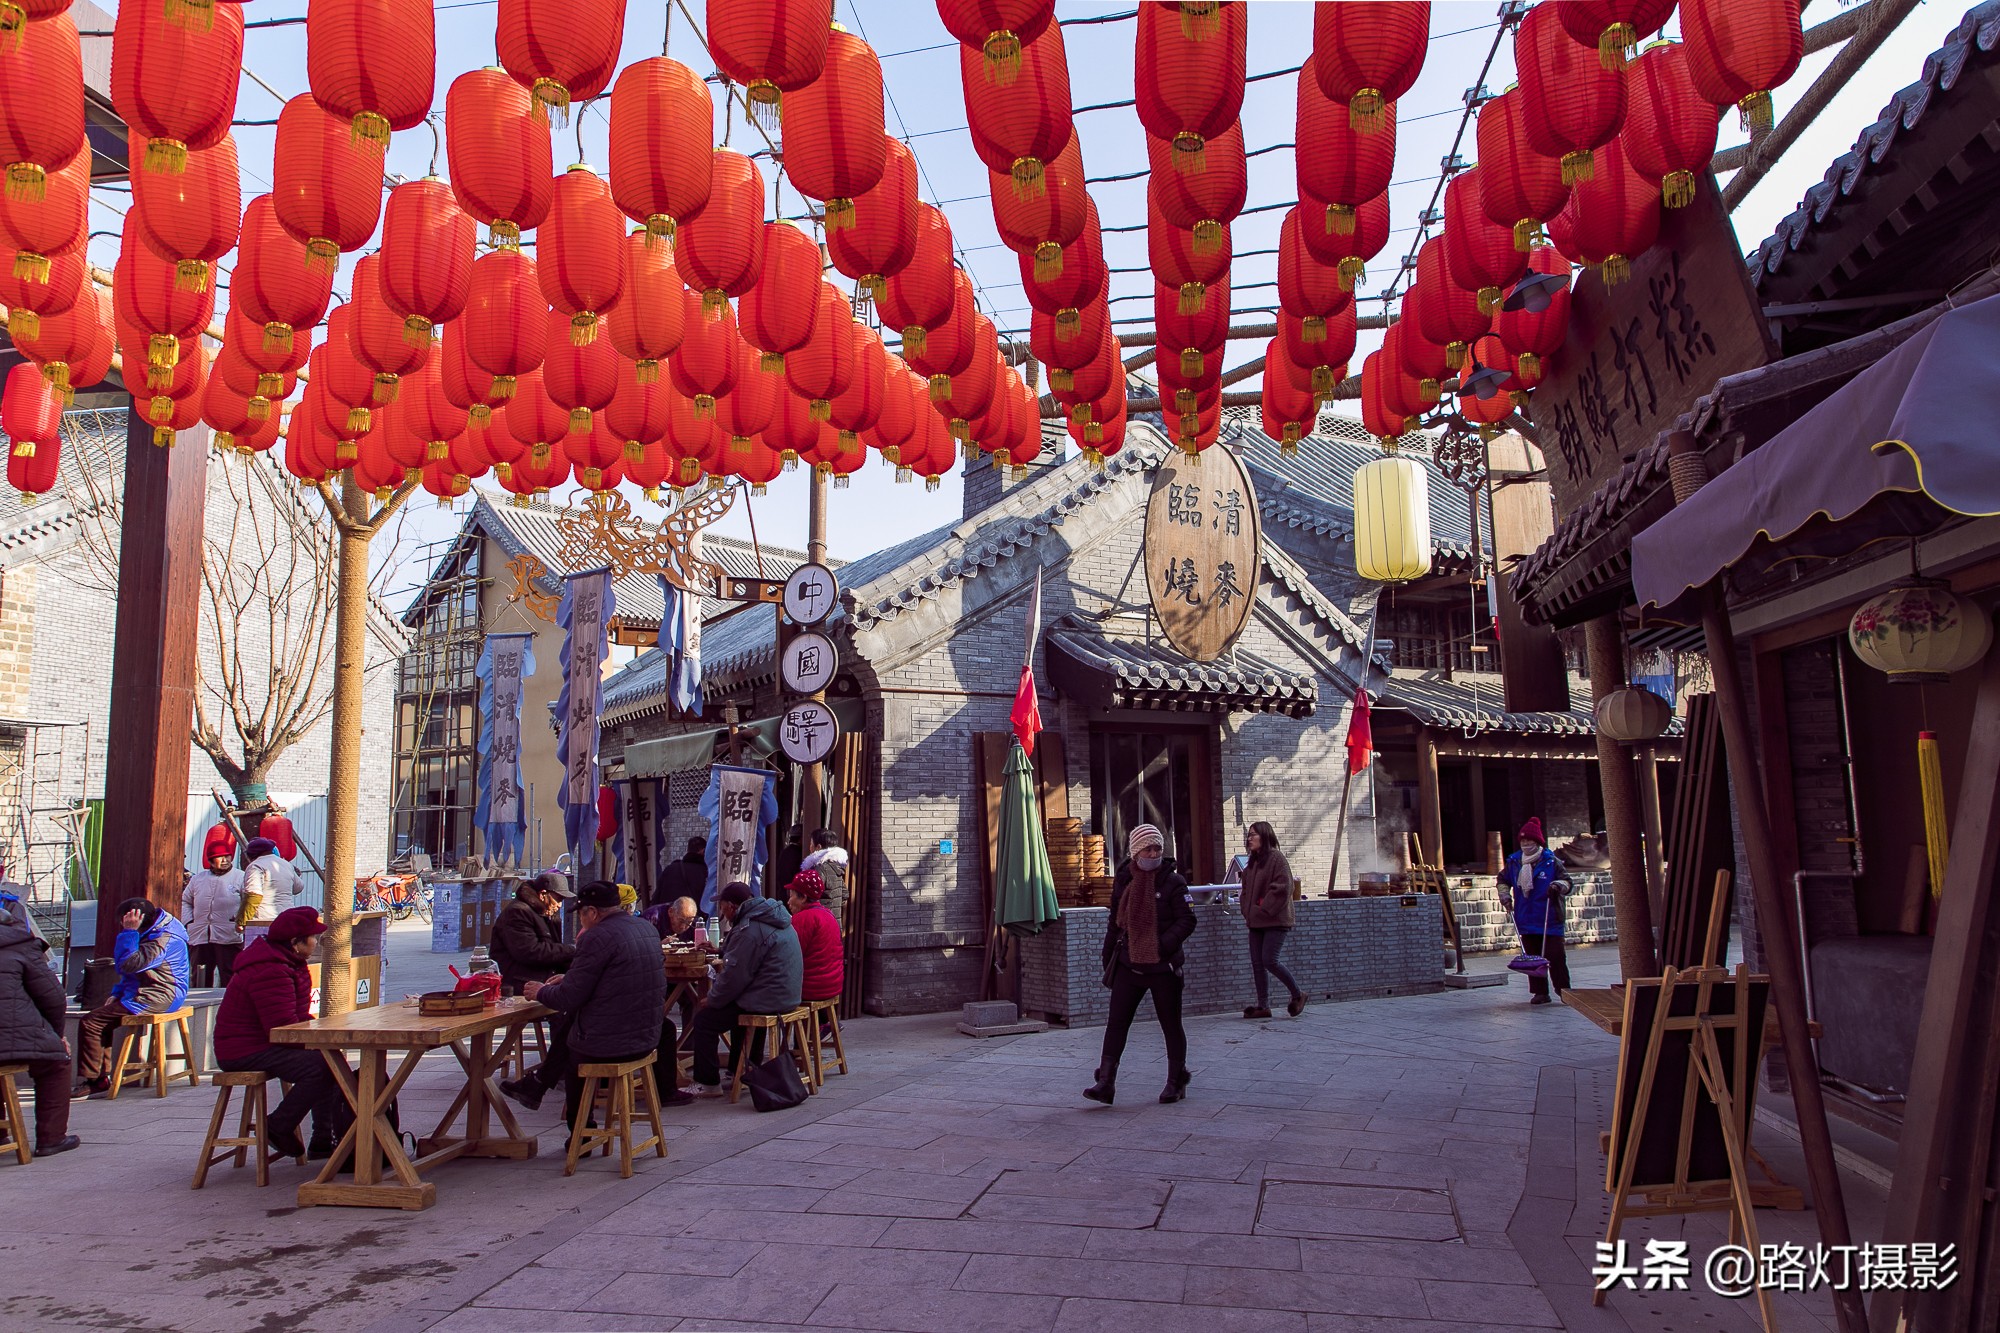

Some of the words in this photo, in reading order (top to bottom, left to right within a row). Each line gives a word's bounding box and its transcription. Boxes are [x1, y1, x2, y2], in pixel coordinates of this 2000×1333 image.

[1168, 482, 1245, 537] 臨清
[492, 652, 519, 808] 臨清燒麥
